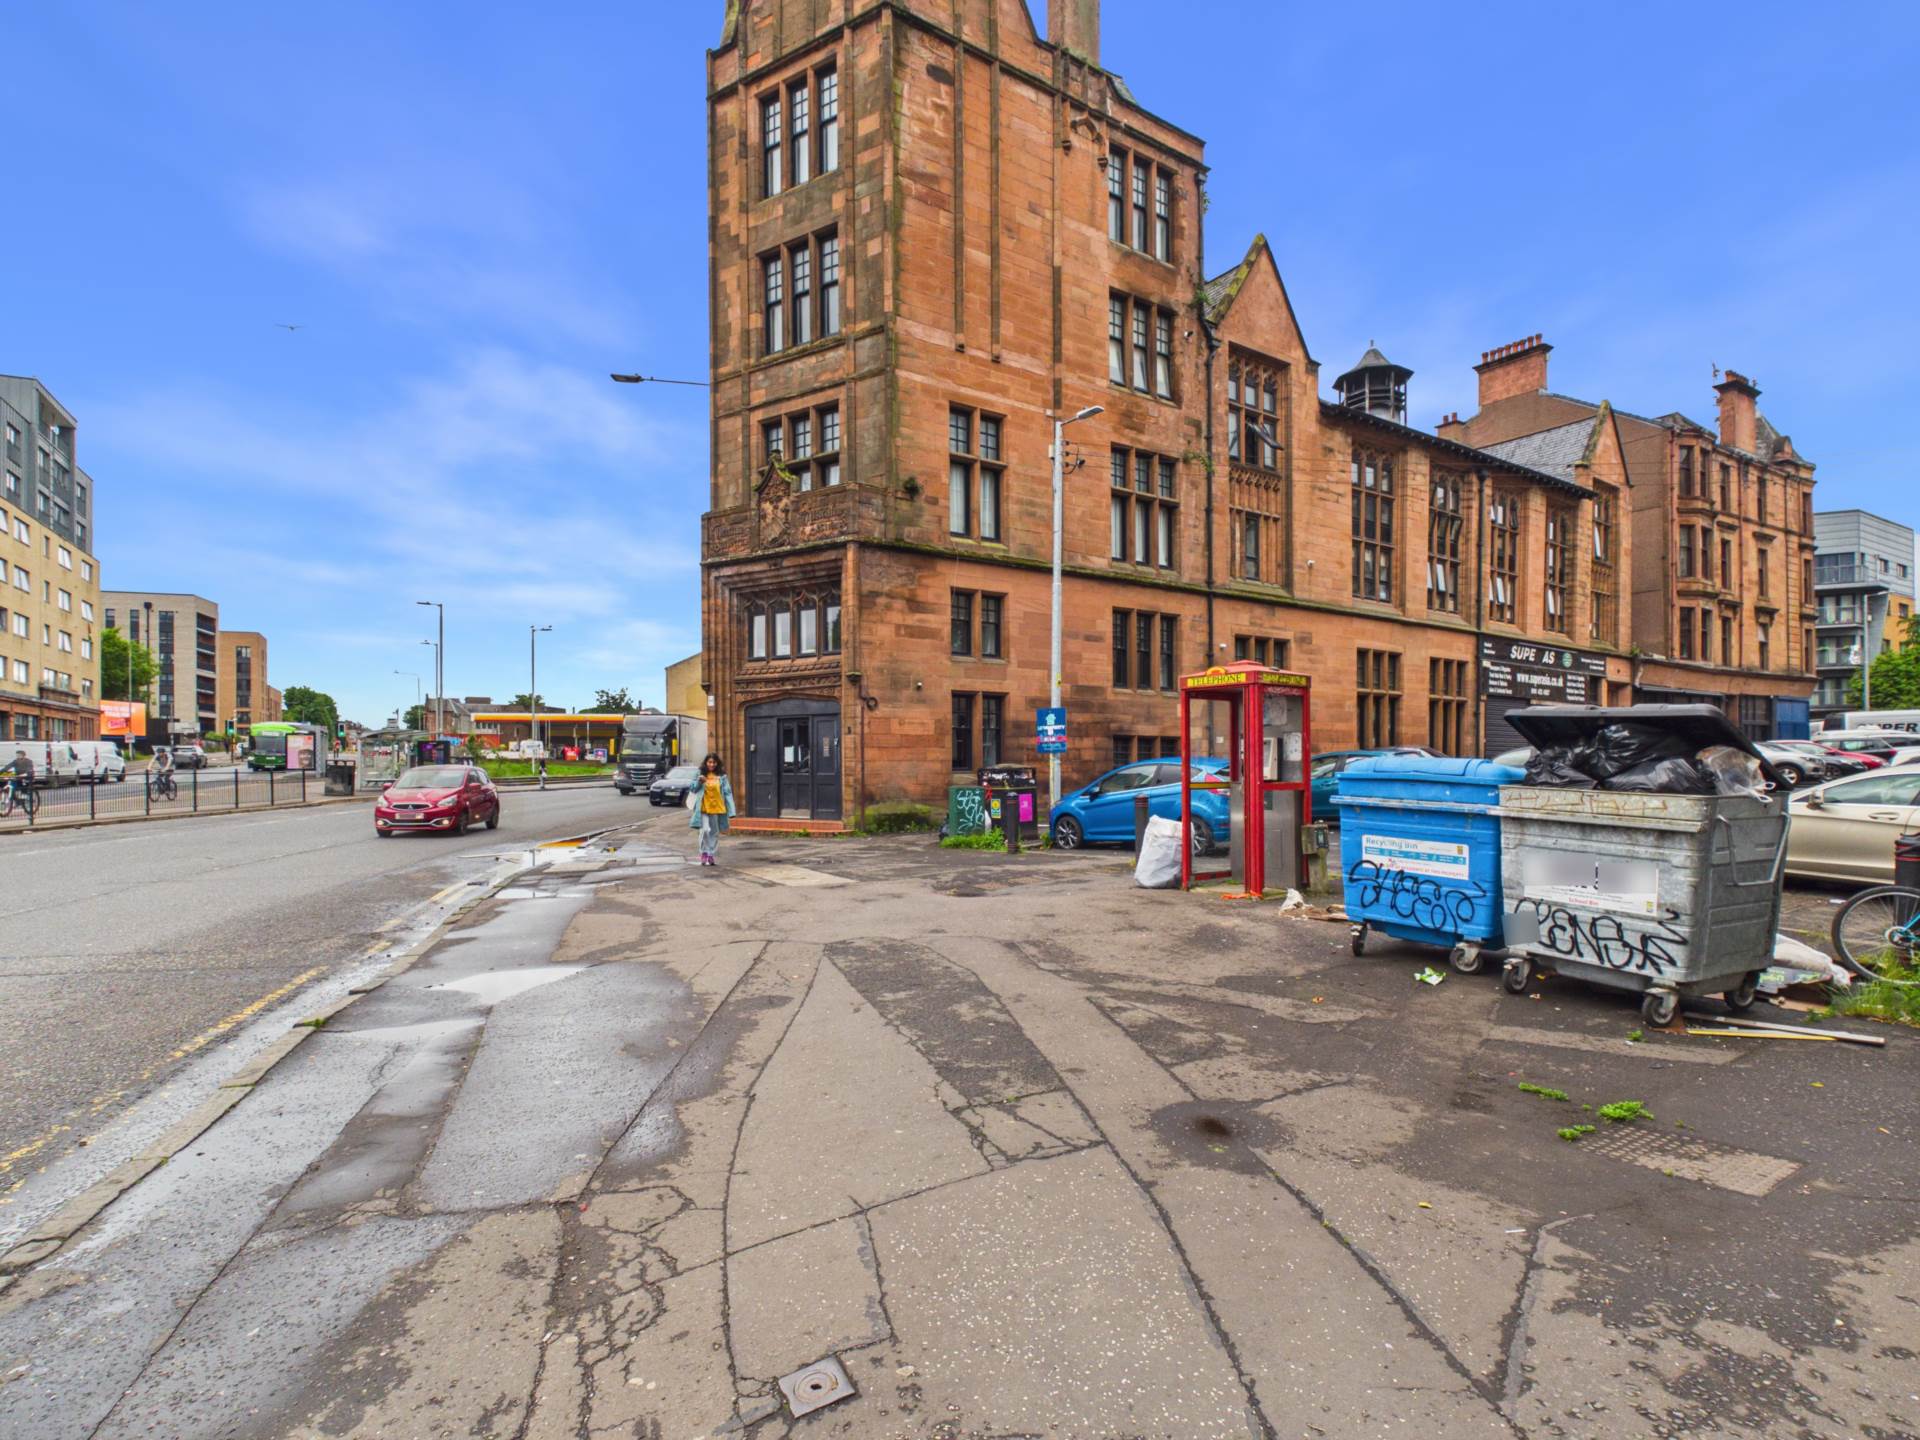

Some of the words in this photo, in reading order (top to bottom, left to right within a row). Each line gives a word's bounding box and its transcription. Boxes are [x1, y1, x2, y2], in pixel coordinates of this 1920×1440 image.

[1510, 645, 1536, 661] SUPE
[1542, 651, 1556, 664] AS
[1192, 674, 1242, 686] TELEPHONE
